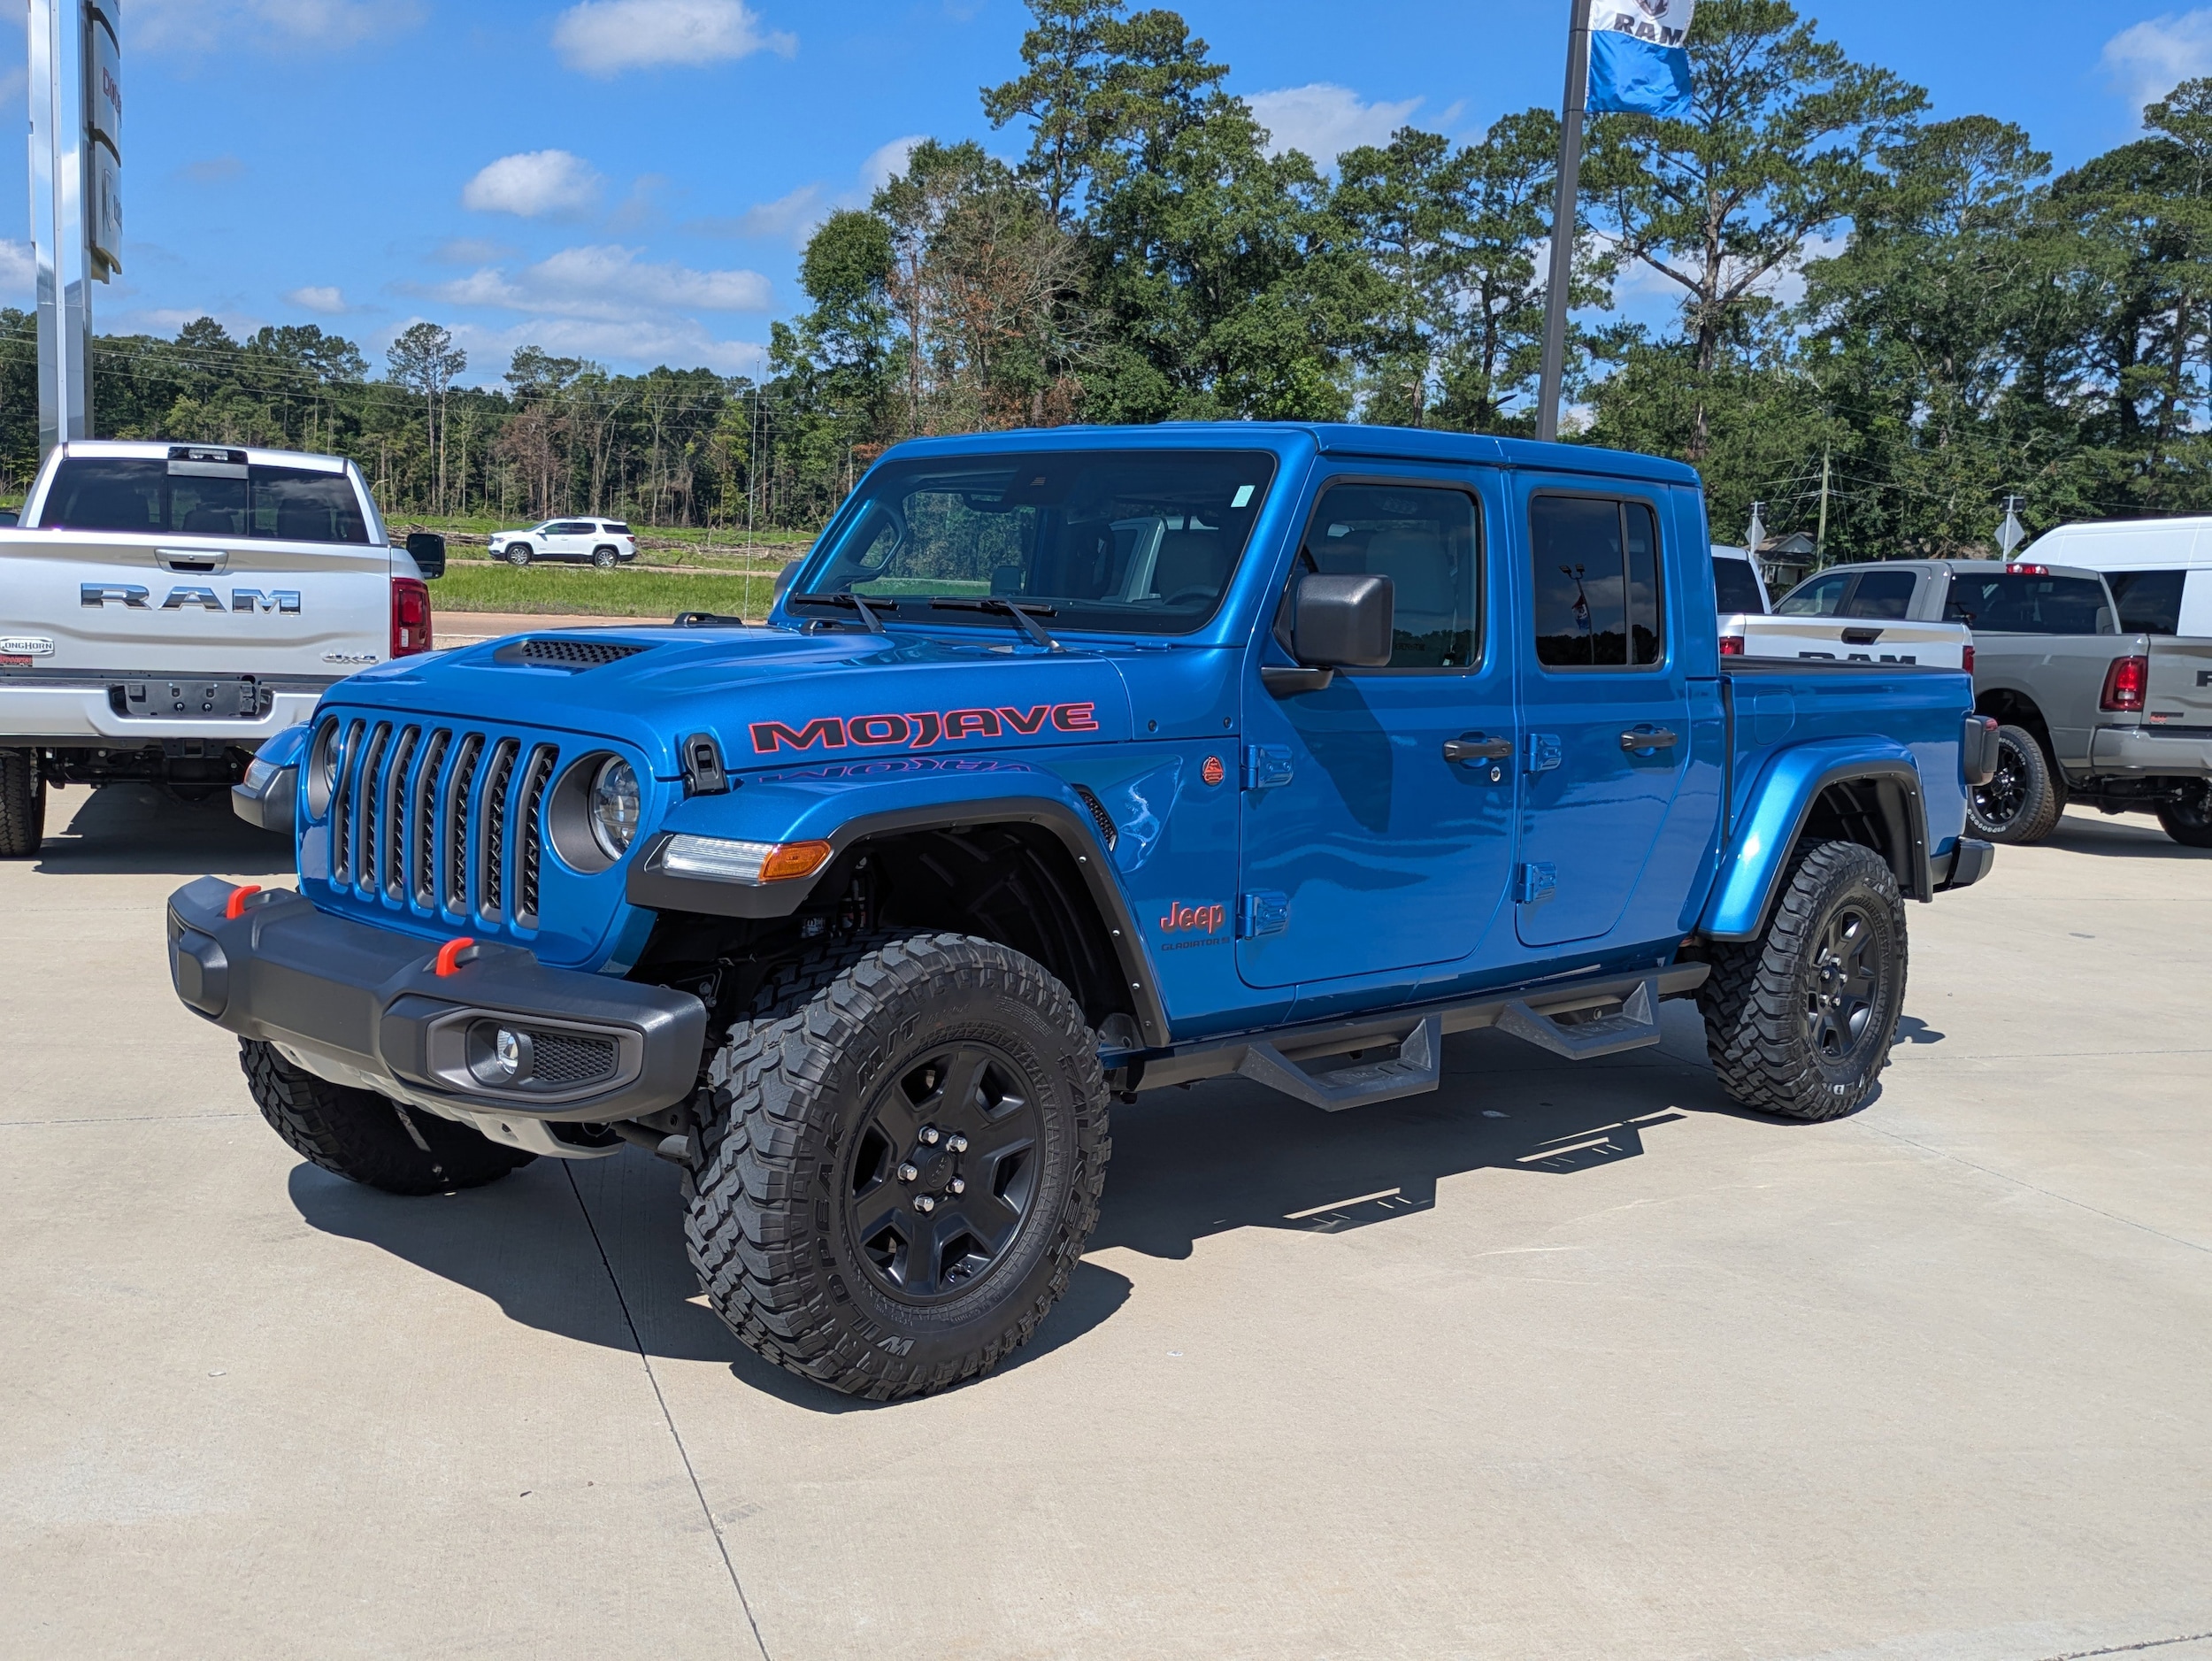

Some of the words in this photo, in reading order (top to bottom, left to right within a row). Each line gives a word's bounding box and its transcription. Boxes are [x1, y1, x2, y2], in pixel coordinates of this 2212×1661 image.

[1613, 12, 1683, 45] RAM
[81, 582, 302, 616] RAM
[1, 642, 52, 650] ONGHORN
[749, 702, 1099, 754] MOJAVE
[1160, 901, 1225, 934] Jeep
[1161, 938, 1220, 952] GLADIATOR
[814, 1112, 917, 1359] WILDPEAK
